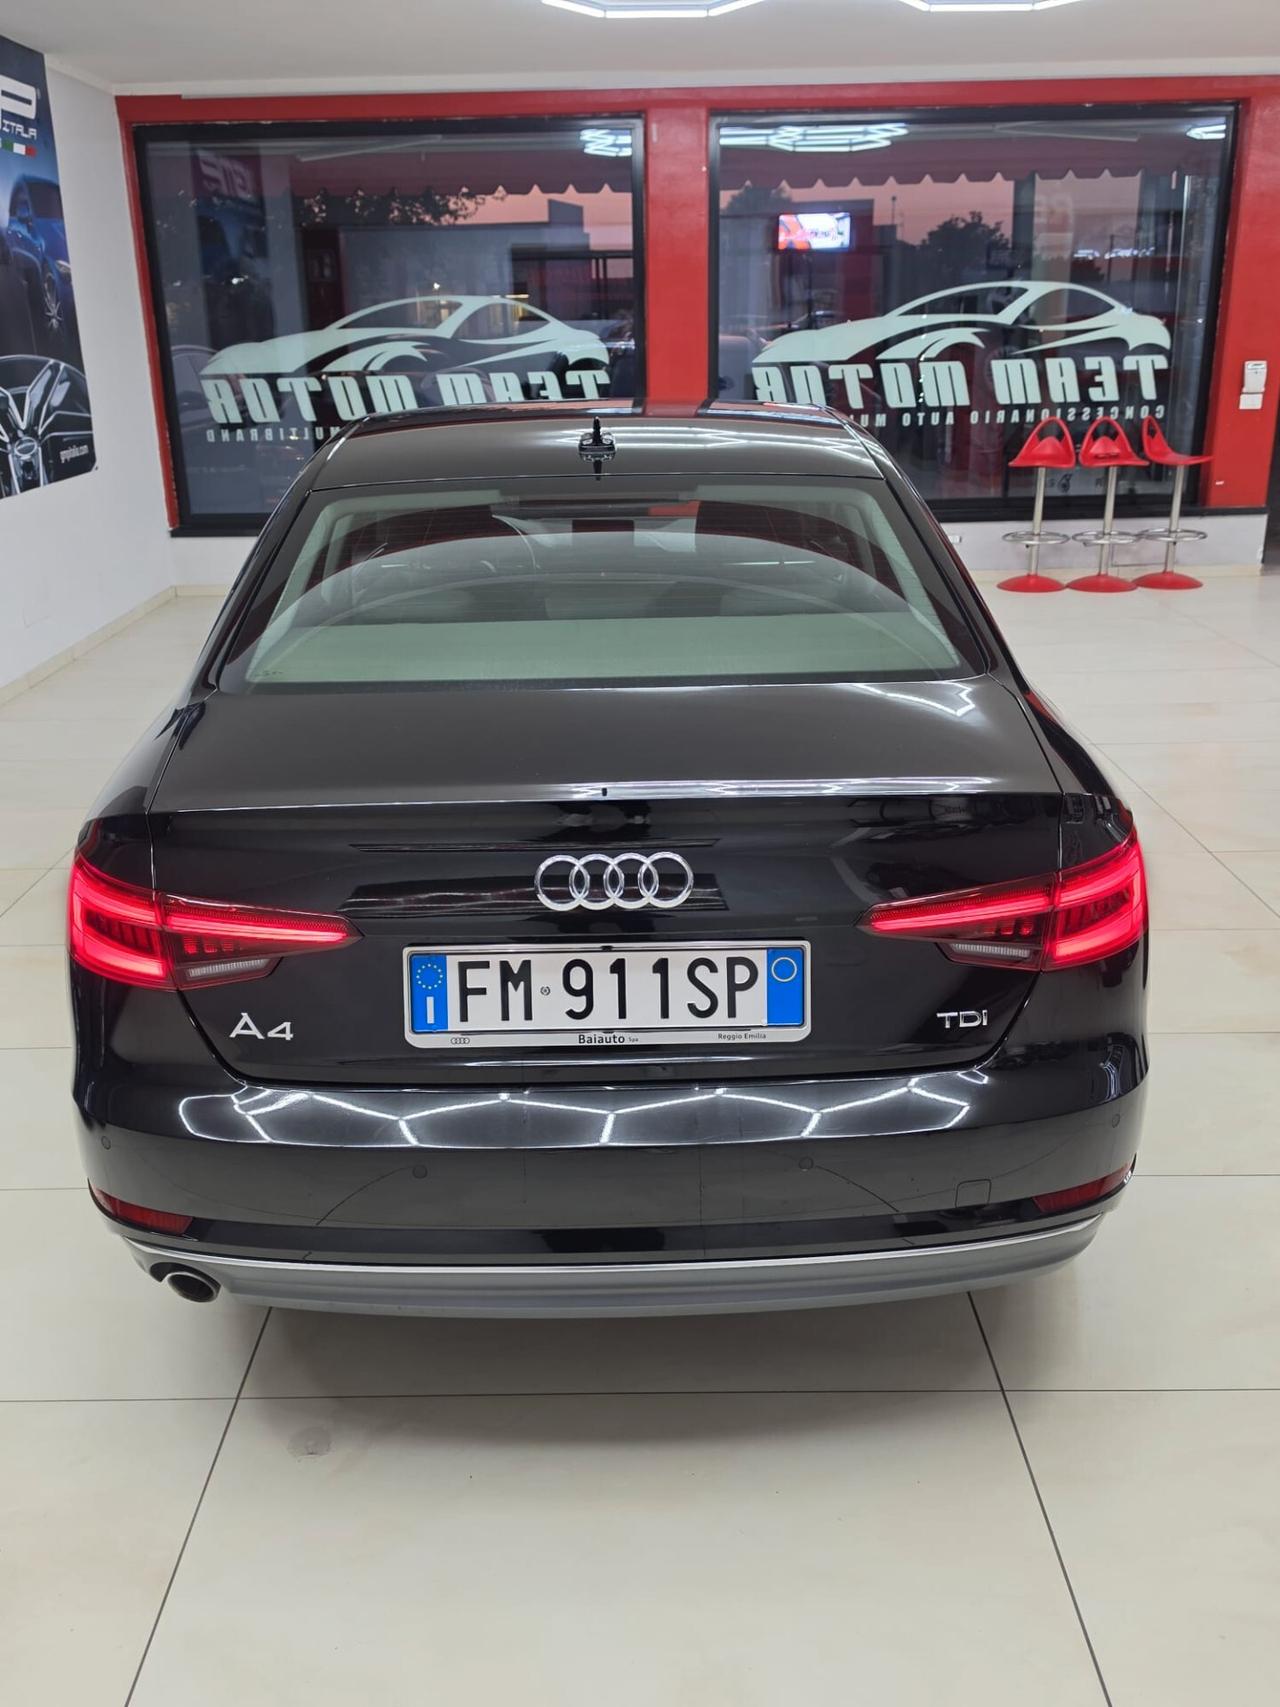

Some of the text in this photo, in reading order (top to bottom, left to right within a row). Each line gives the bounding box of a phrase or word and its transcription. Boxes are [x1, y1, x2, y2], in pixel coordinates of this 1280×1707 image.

[229, 1012, 294, 1041] A4
[578, 1034, 625, 1044] Baiauto
[718, 1032, 766, 1041] Reggio Emilia
